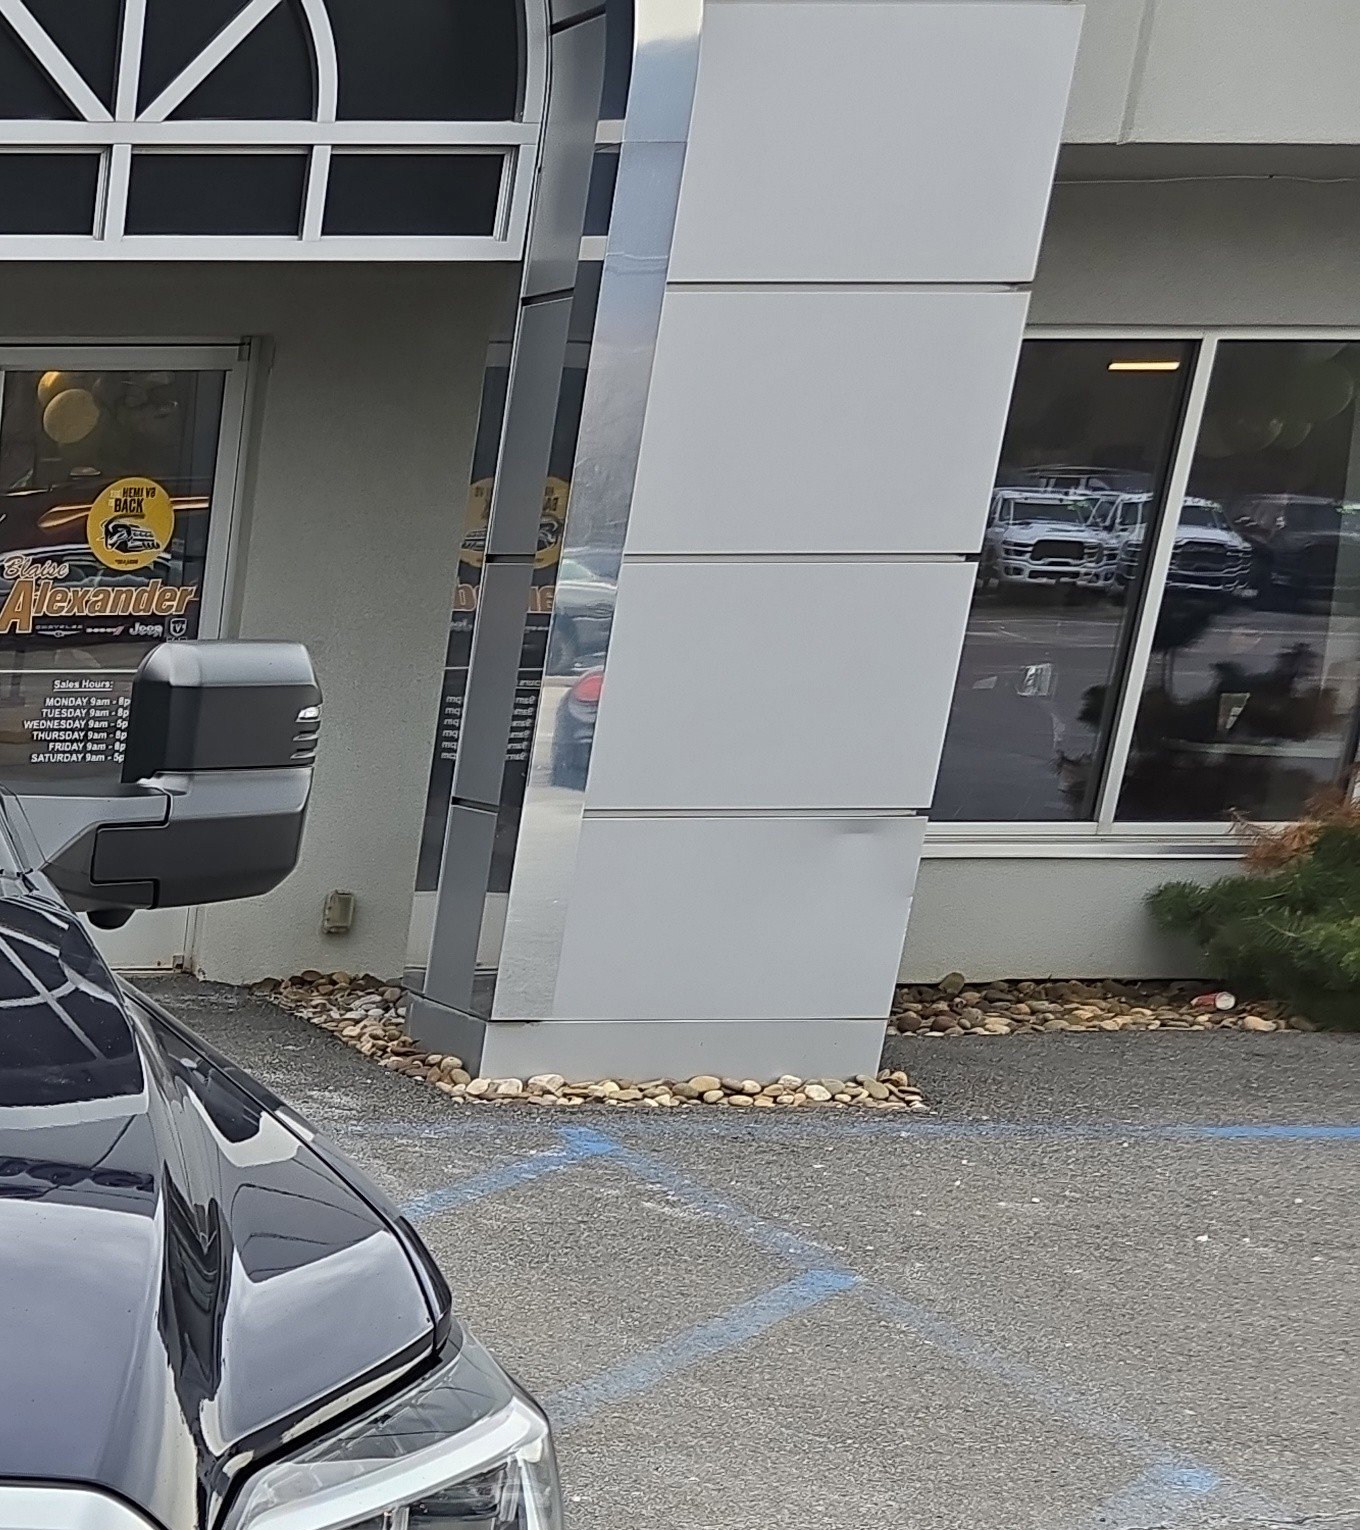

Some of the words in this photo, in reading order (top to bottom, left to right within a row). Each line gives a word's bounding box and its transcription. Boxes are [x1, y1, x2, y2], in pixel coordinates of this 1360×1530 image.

[114, 498, 144, 512] BACK
[3, 553, 70, 579] Blaise
[129, 622, 163, 637] Jeep
[53, 680, 79, 689] Sales
[82, 680, 114, 689] Hours:
[44, 697, 89, 706] MONDAY
[90, 697, 110, 706] 9am
[118, 696, 131, 707] 8p
[41, 708, 87, 717] TUESDAY
[89, 708, 109, 717] 9am
[117, 708, 129, 718] 8p
[23, 719, 86, 729] WEDNESDAY
[88, 720, 108, 728] 9am
[32, 731, 85, 740] THURSDAY
[87, 731, 107, 740] 9am
[115, 730, 127, 741] 8p
[48, 742, 84, 751] FRIDAY
[86, 742, 106, 751] 9am
[30, 753, 84, 762] SATURDAY
[86, 753, 105, 762] 9am
